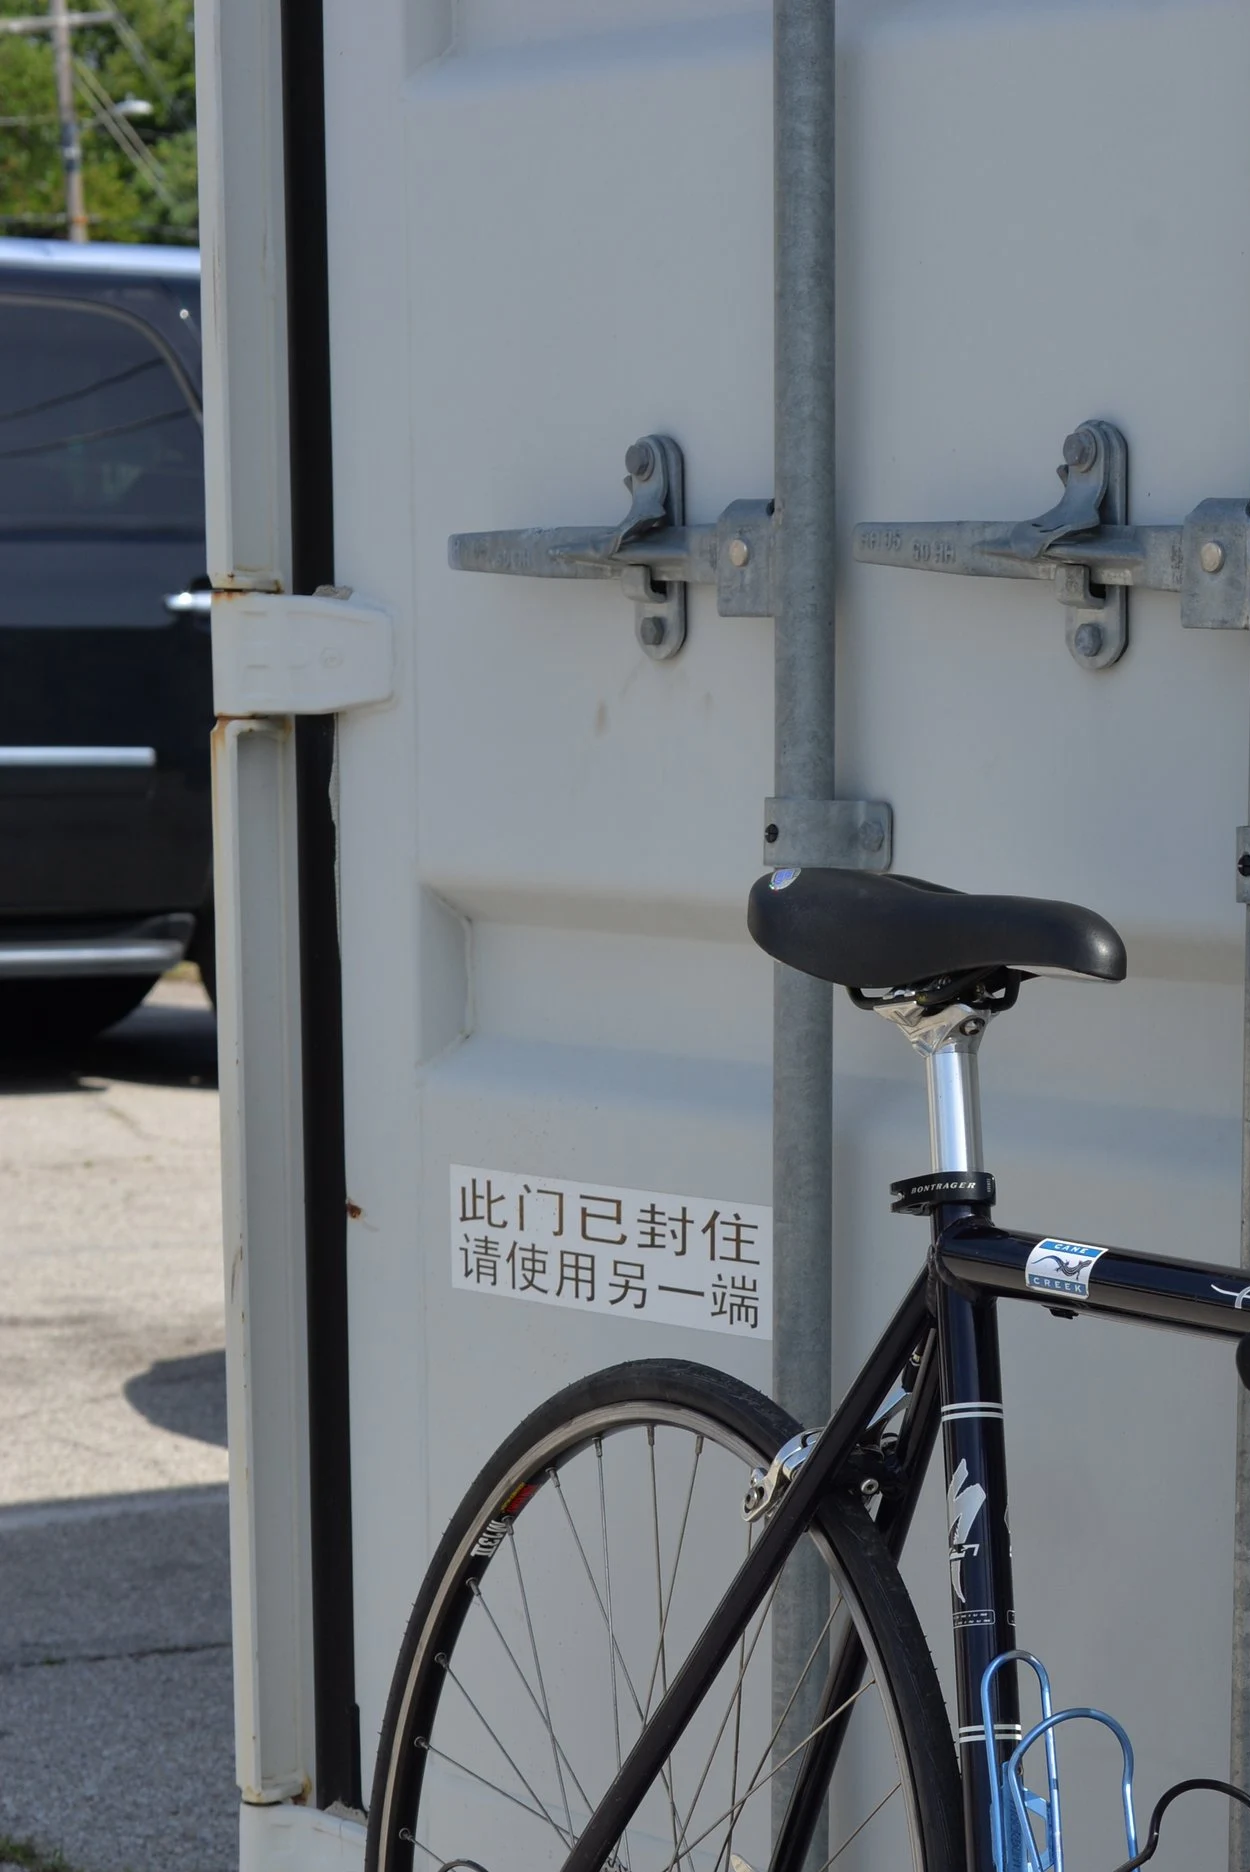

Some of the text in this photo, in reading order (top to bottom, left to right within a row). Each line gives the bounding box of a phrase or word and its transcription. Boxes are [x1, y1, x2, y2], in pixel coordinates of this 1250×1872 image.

[910, 1181, 977, 1195] BONTRAGER
[459, 1177, 761, 1266] 此门已封住
[1054, 1243, 1089, 1255] CANE
[459, 1233, 760, 1330] 请使用另一端
[1033, 1277, 1082, 1293] CREEK
